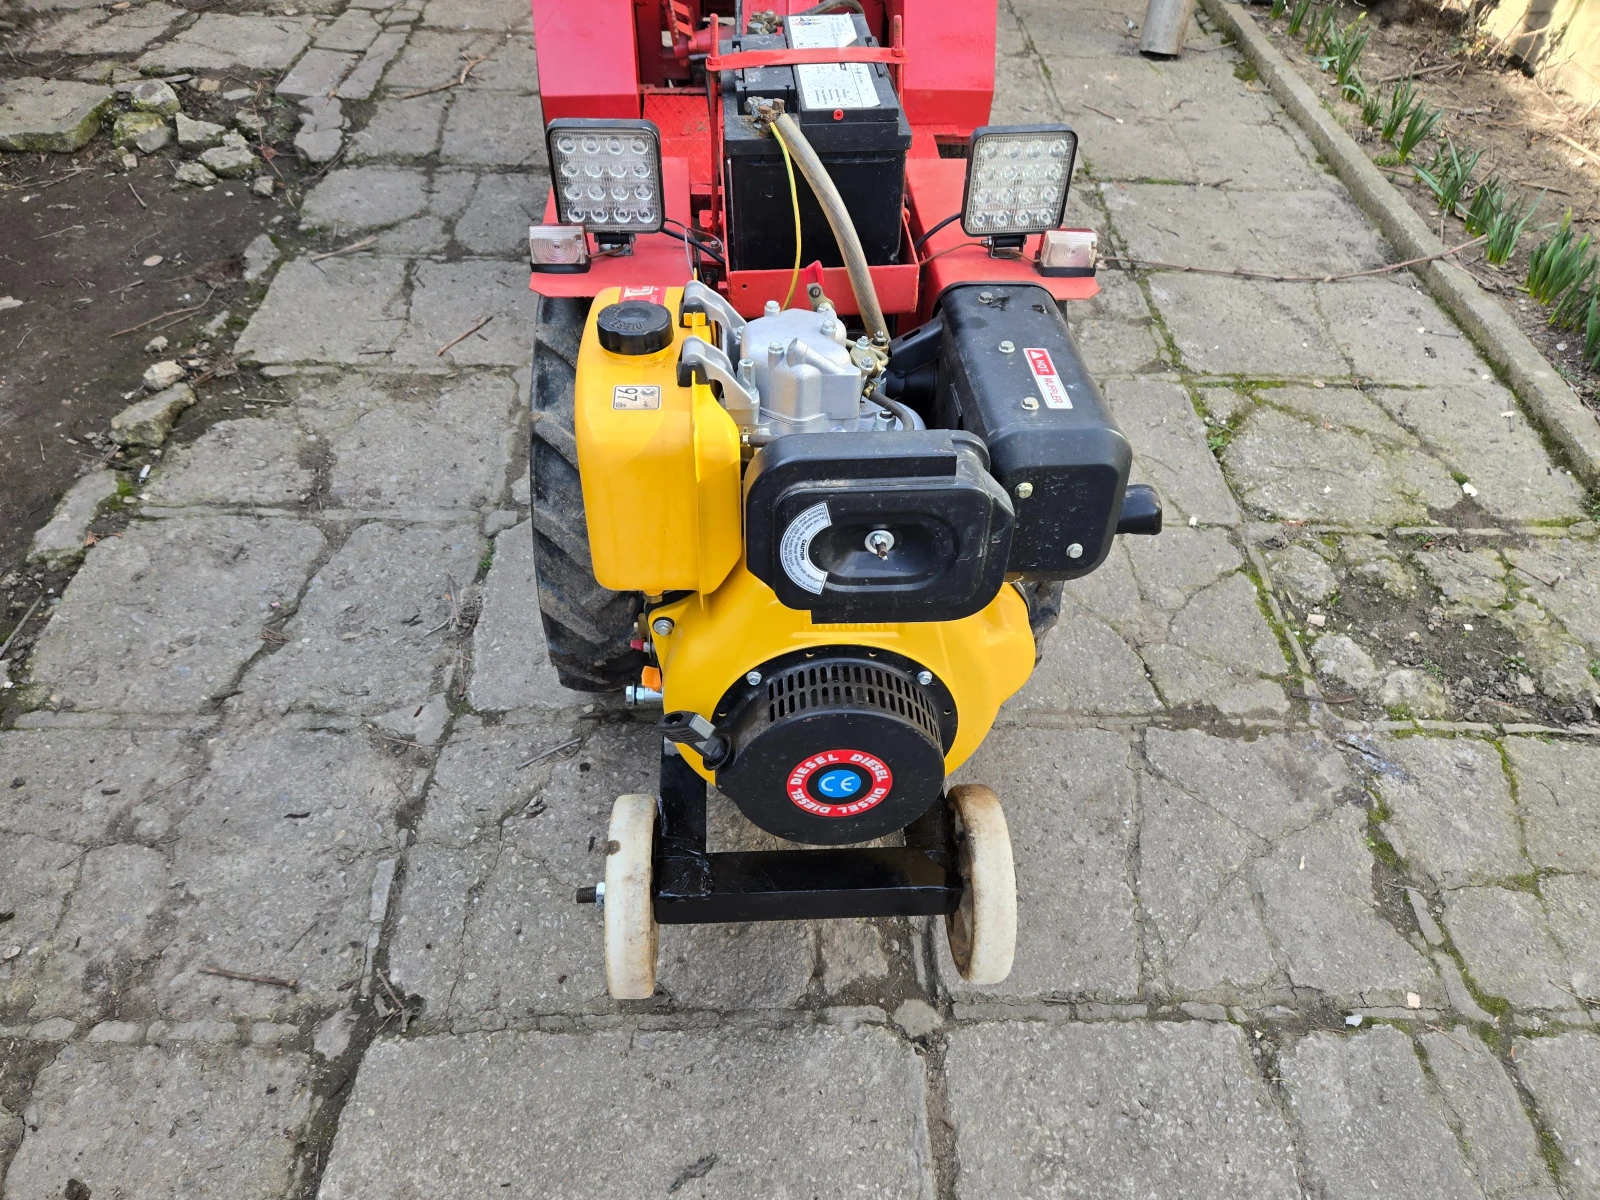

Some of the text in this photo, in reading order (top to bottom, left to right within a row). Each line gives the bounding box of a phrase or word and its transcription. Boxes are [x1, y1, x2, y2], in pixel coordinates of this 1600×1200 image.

[617, 387, 638, 401] 97
[1043, 377, 1063, 404] MUFFLER
[799, 539, 808, 561] CAUTION
[790, 754, 839, 785] DIESEL
[849, 753, 889, 782] DIESEL
[820, 776, 855, 792] CE
[790, 788, 832, 814] DIESEL
[837, 788, 887, 814] DIESEL
